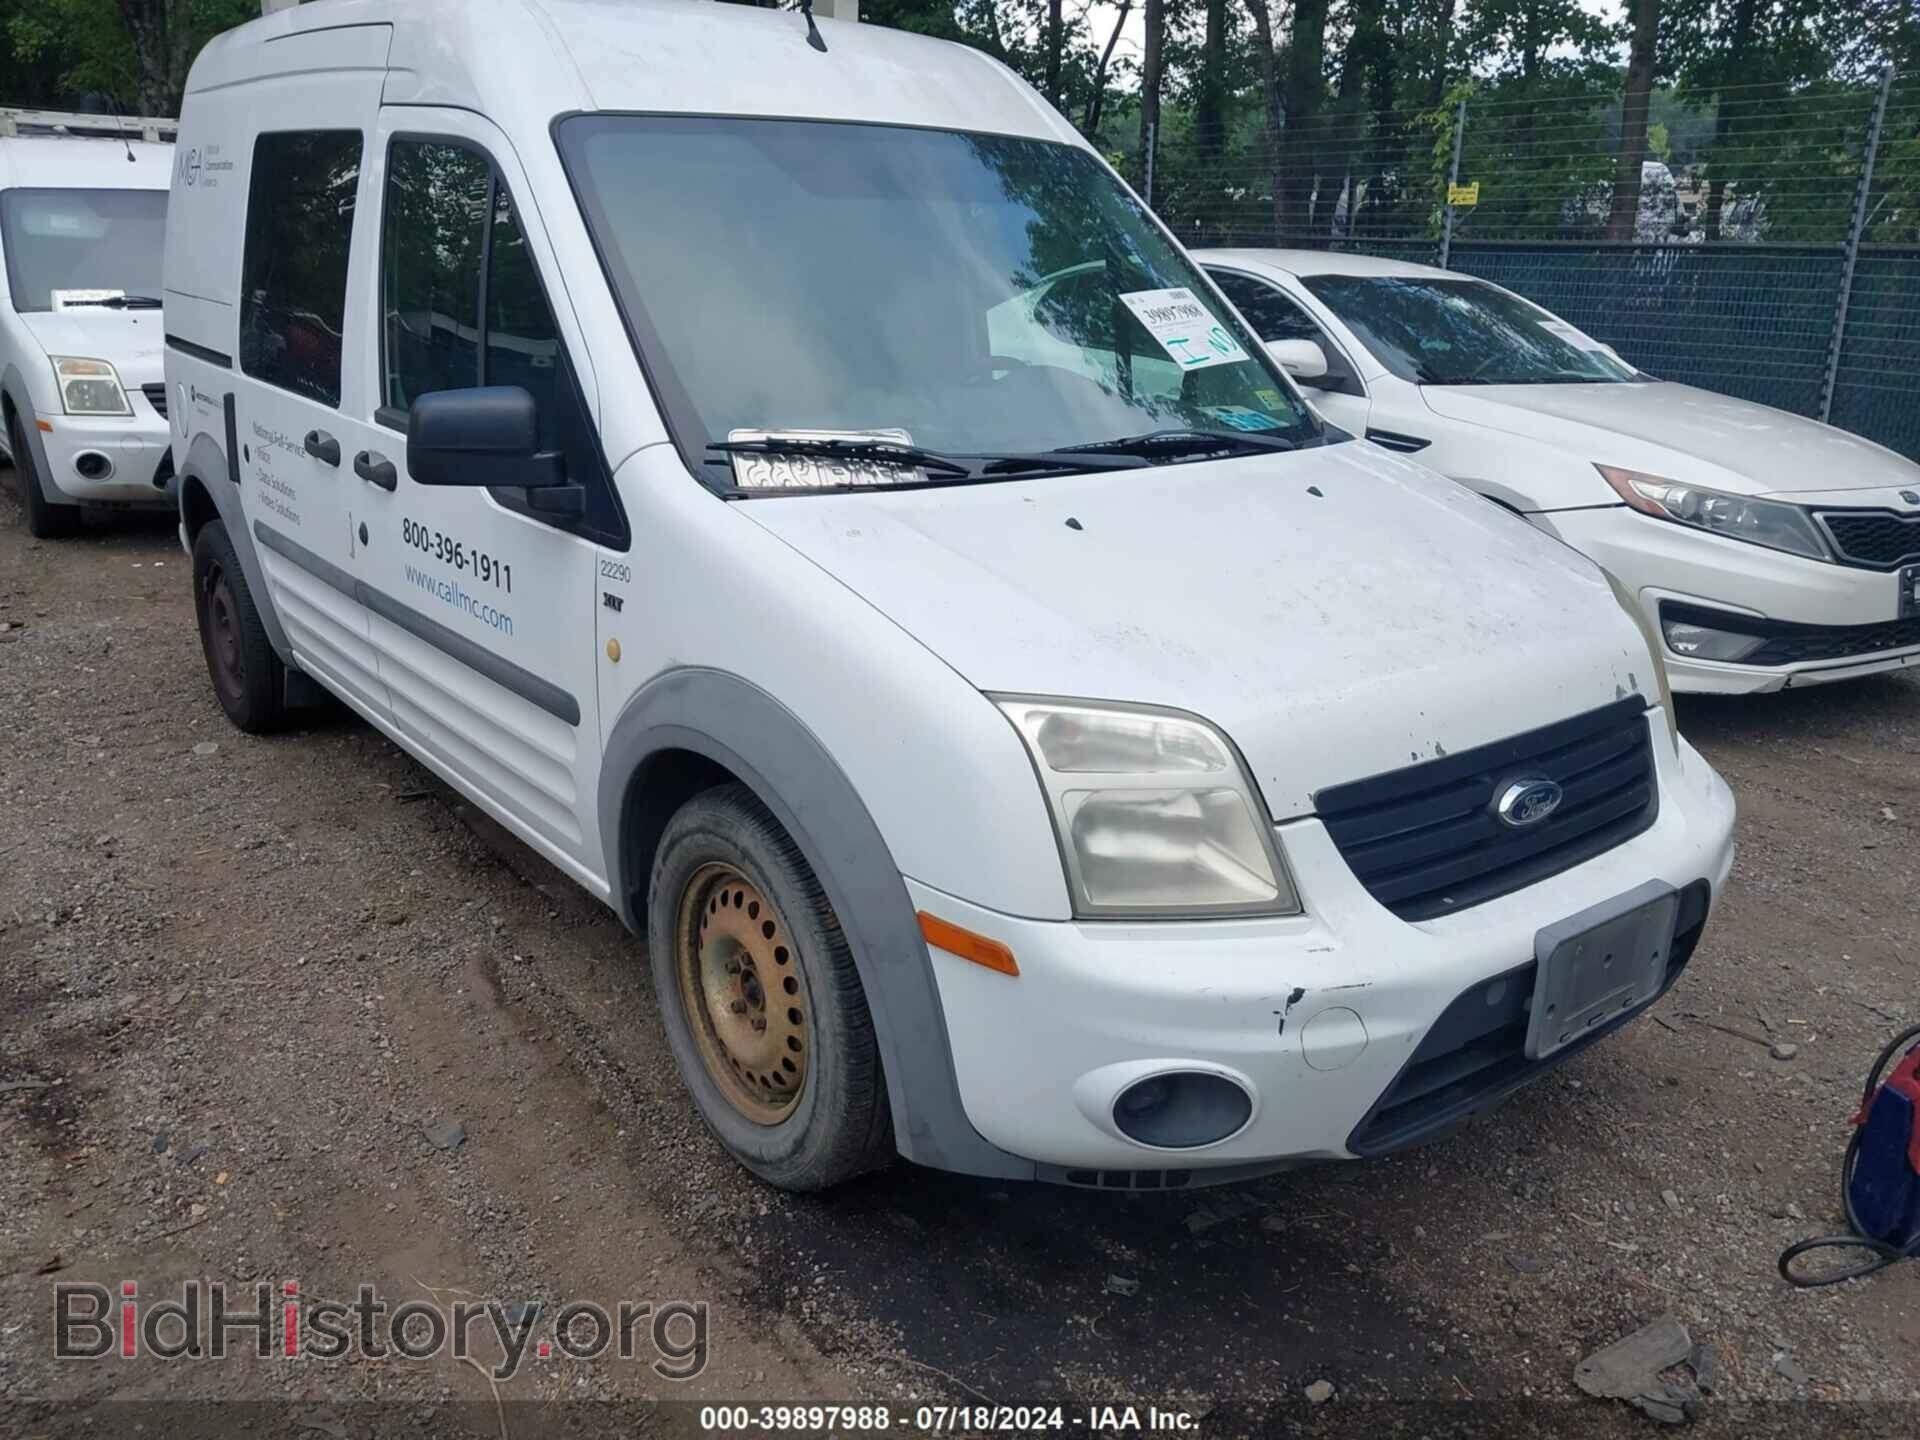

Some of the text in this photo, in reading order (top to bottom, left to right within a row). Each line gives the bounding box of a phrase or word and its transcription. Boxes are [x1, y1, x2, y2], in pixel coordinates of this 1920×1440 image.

[403, 517, 511, 594] 800-396-1911
[600, 559, 632, 584] 22290
[404, 563, 514, 636] www.callmc.com
[1520, 791, 1553, 818] Ford
